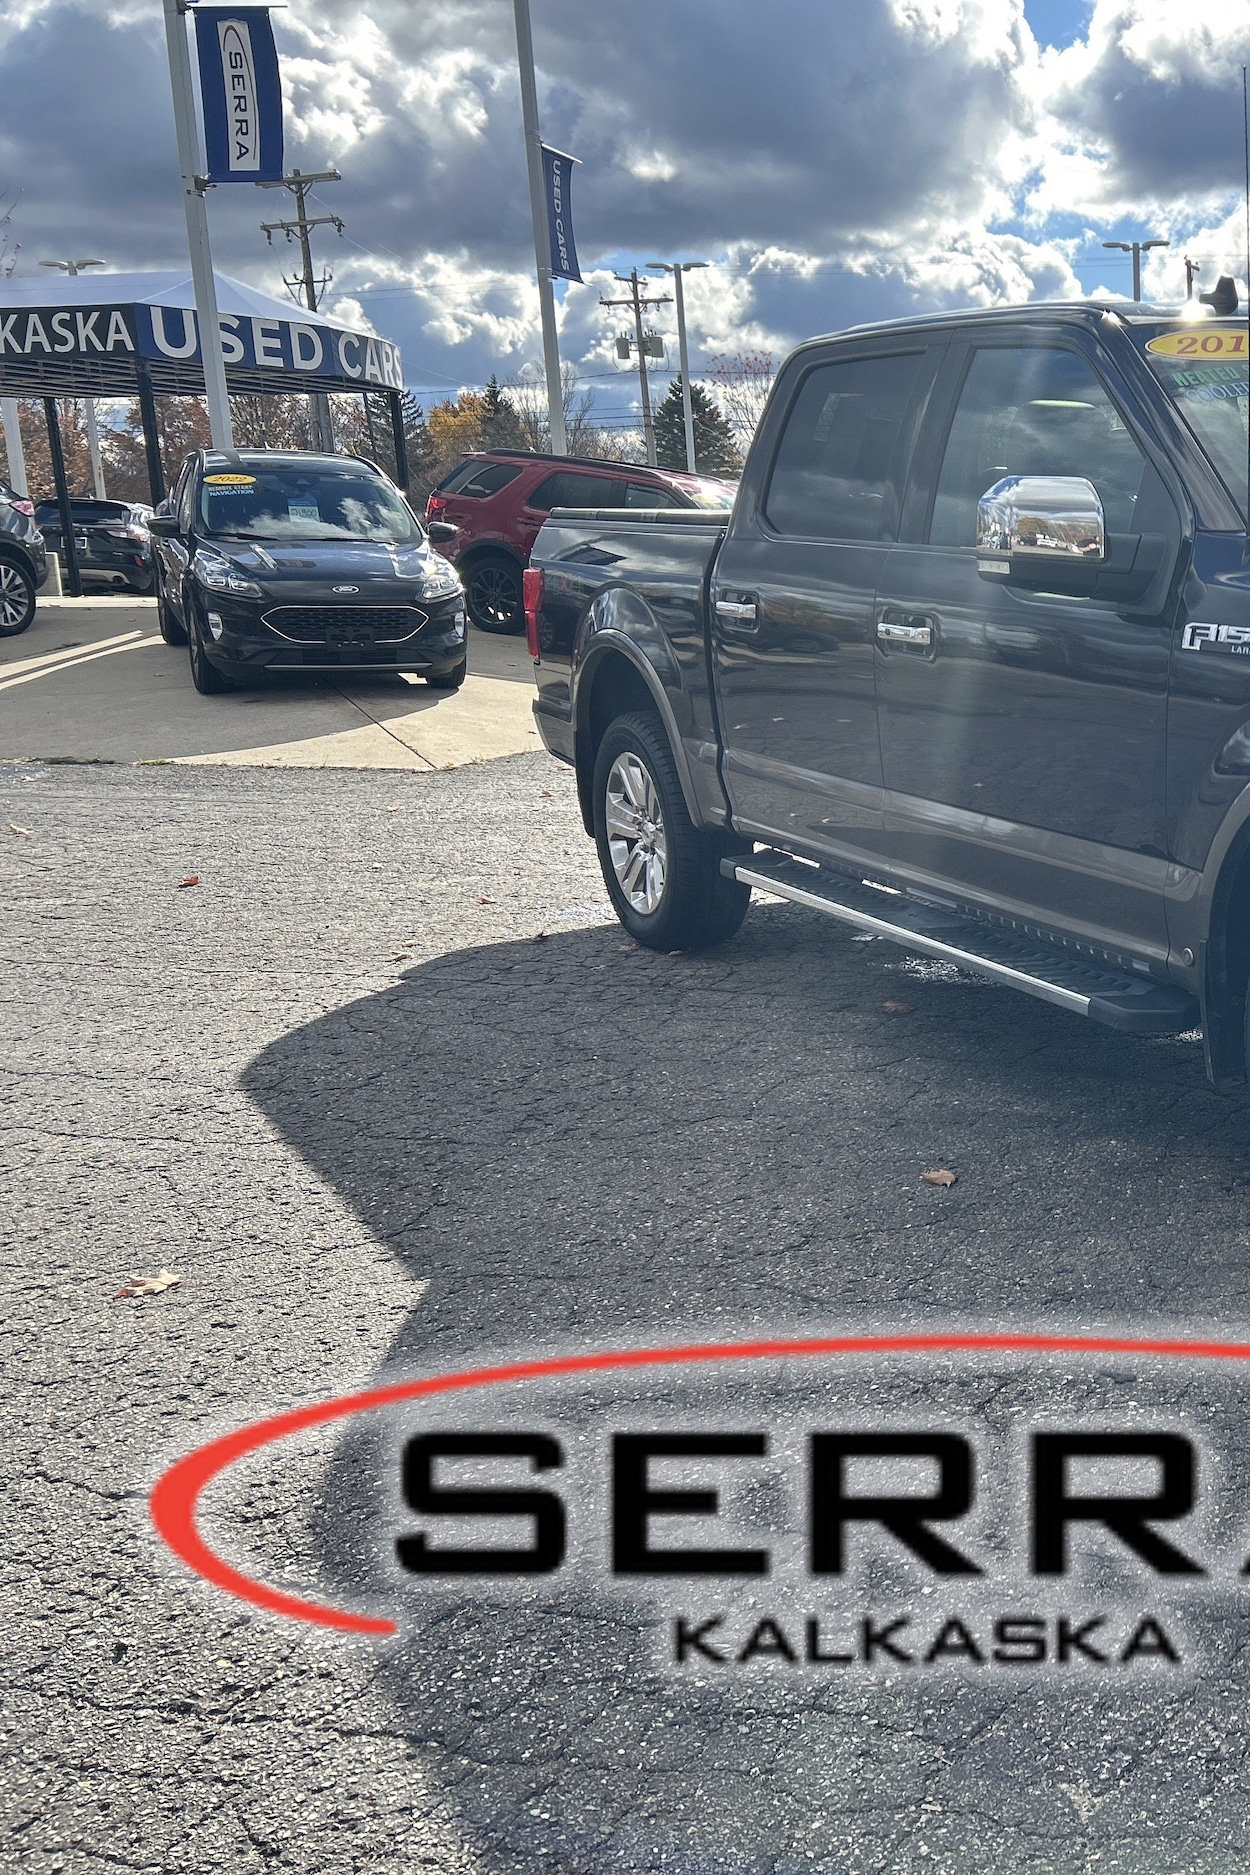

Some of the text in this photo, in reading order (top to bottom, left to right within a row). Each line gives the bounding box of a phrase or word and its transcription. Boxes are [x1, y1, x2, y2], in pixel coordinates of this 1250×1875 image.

[228, 51, 250, 161] SERRA
[553, 160, 570, 271] USED CARS
[0, 306, 403, 390] KASKA USED CARS
[1172, 366, 1240, 387] HEATED
